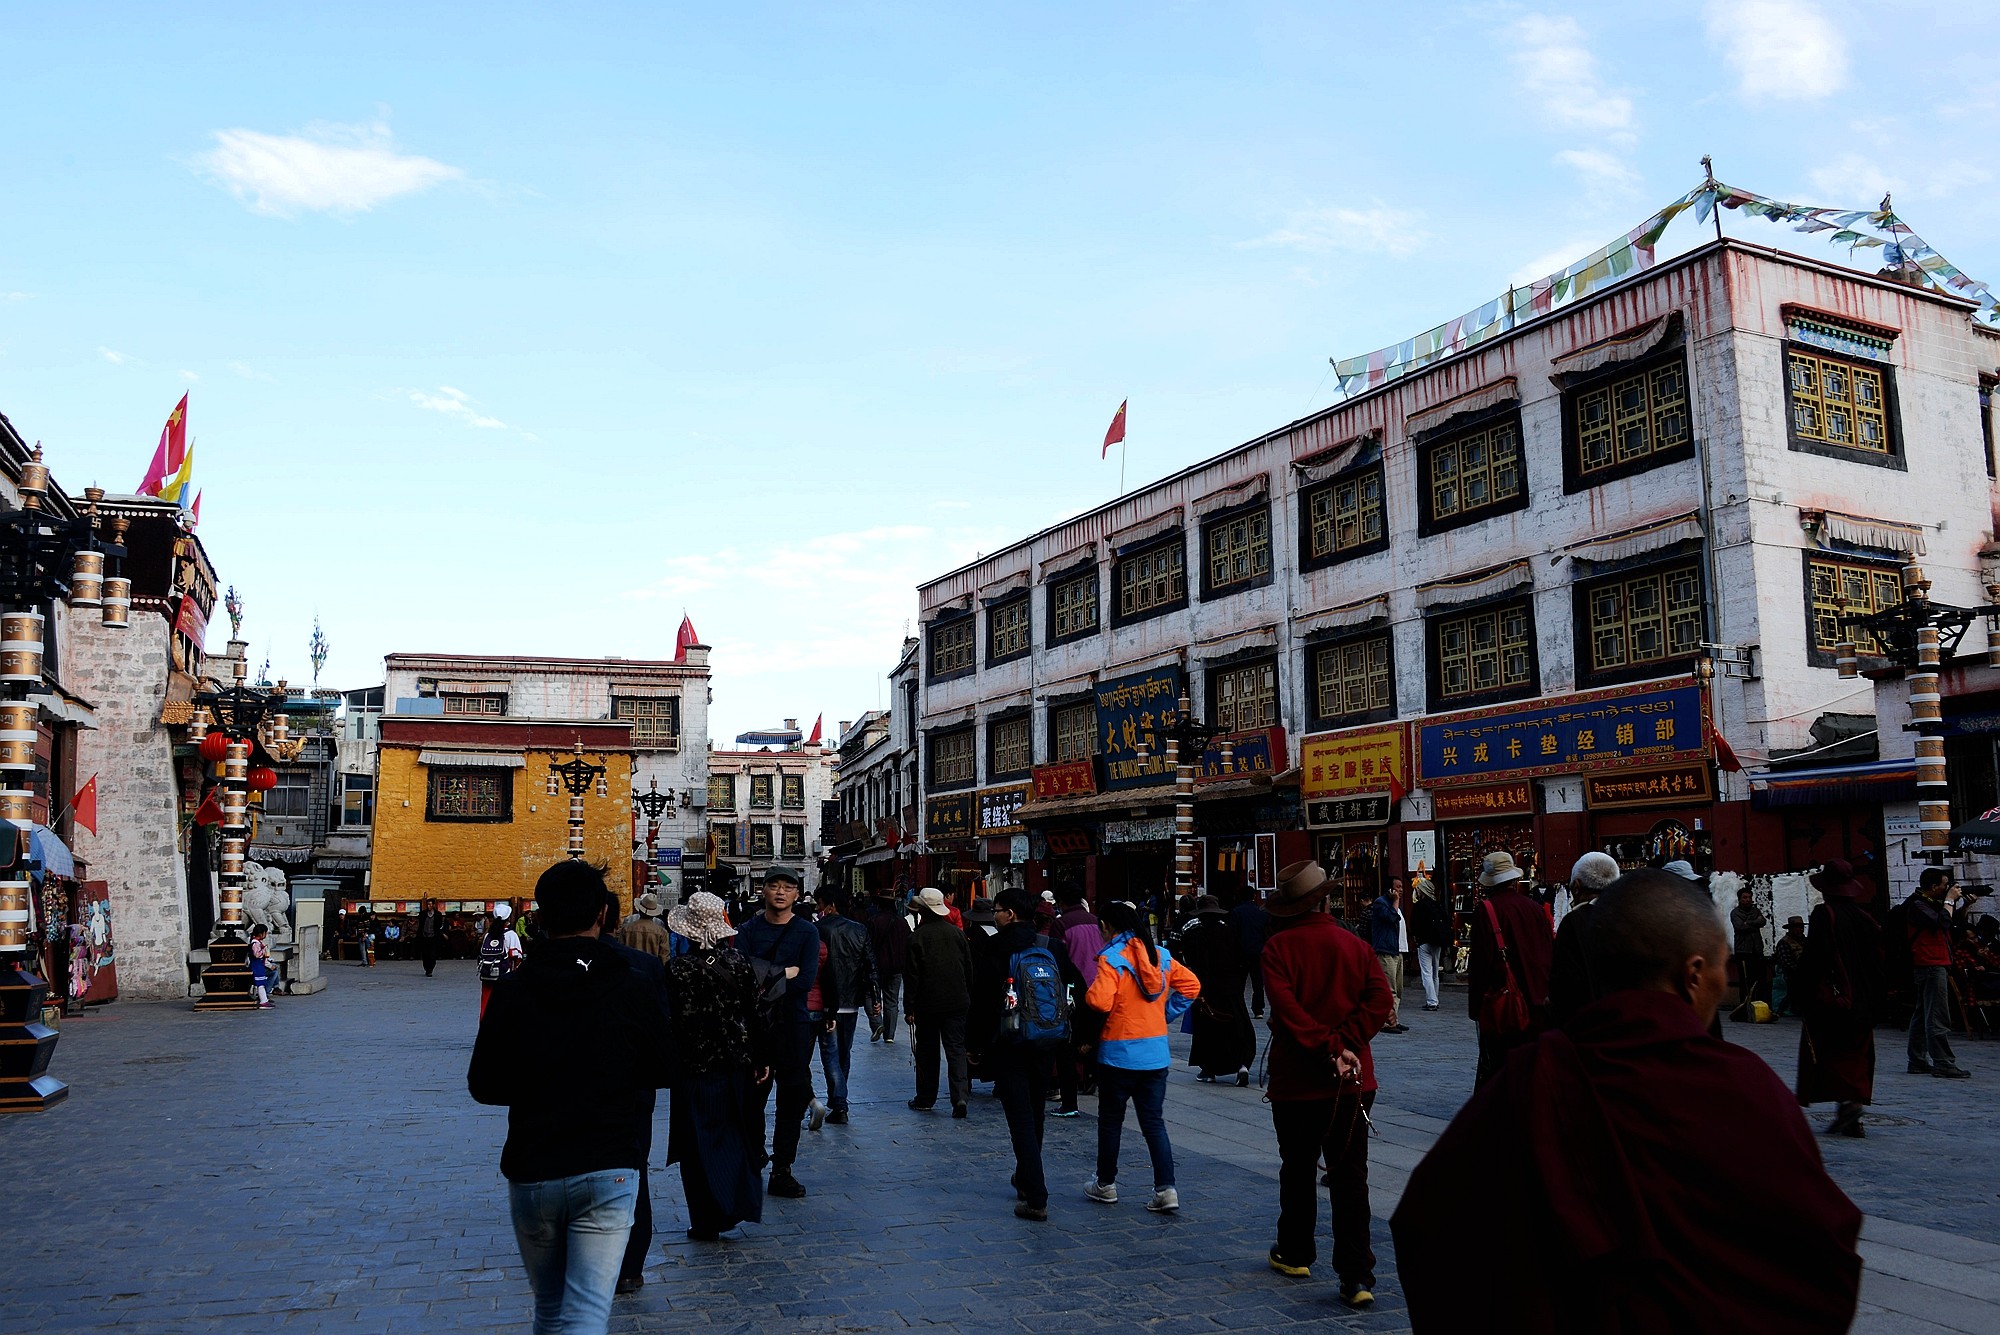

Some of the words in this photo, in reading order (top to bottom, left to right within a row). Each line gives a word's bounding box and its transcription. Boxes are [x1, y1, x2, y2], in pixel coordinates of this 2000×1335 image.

[1443, 718, 1675, 766] 兴戎卡垫经销部
[1108, 761, 1119, 780] THE
